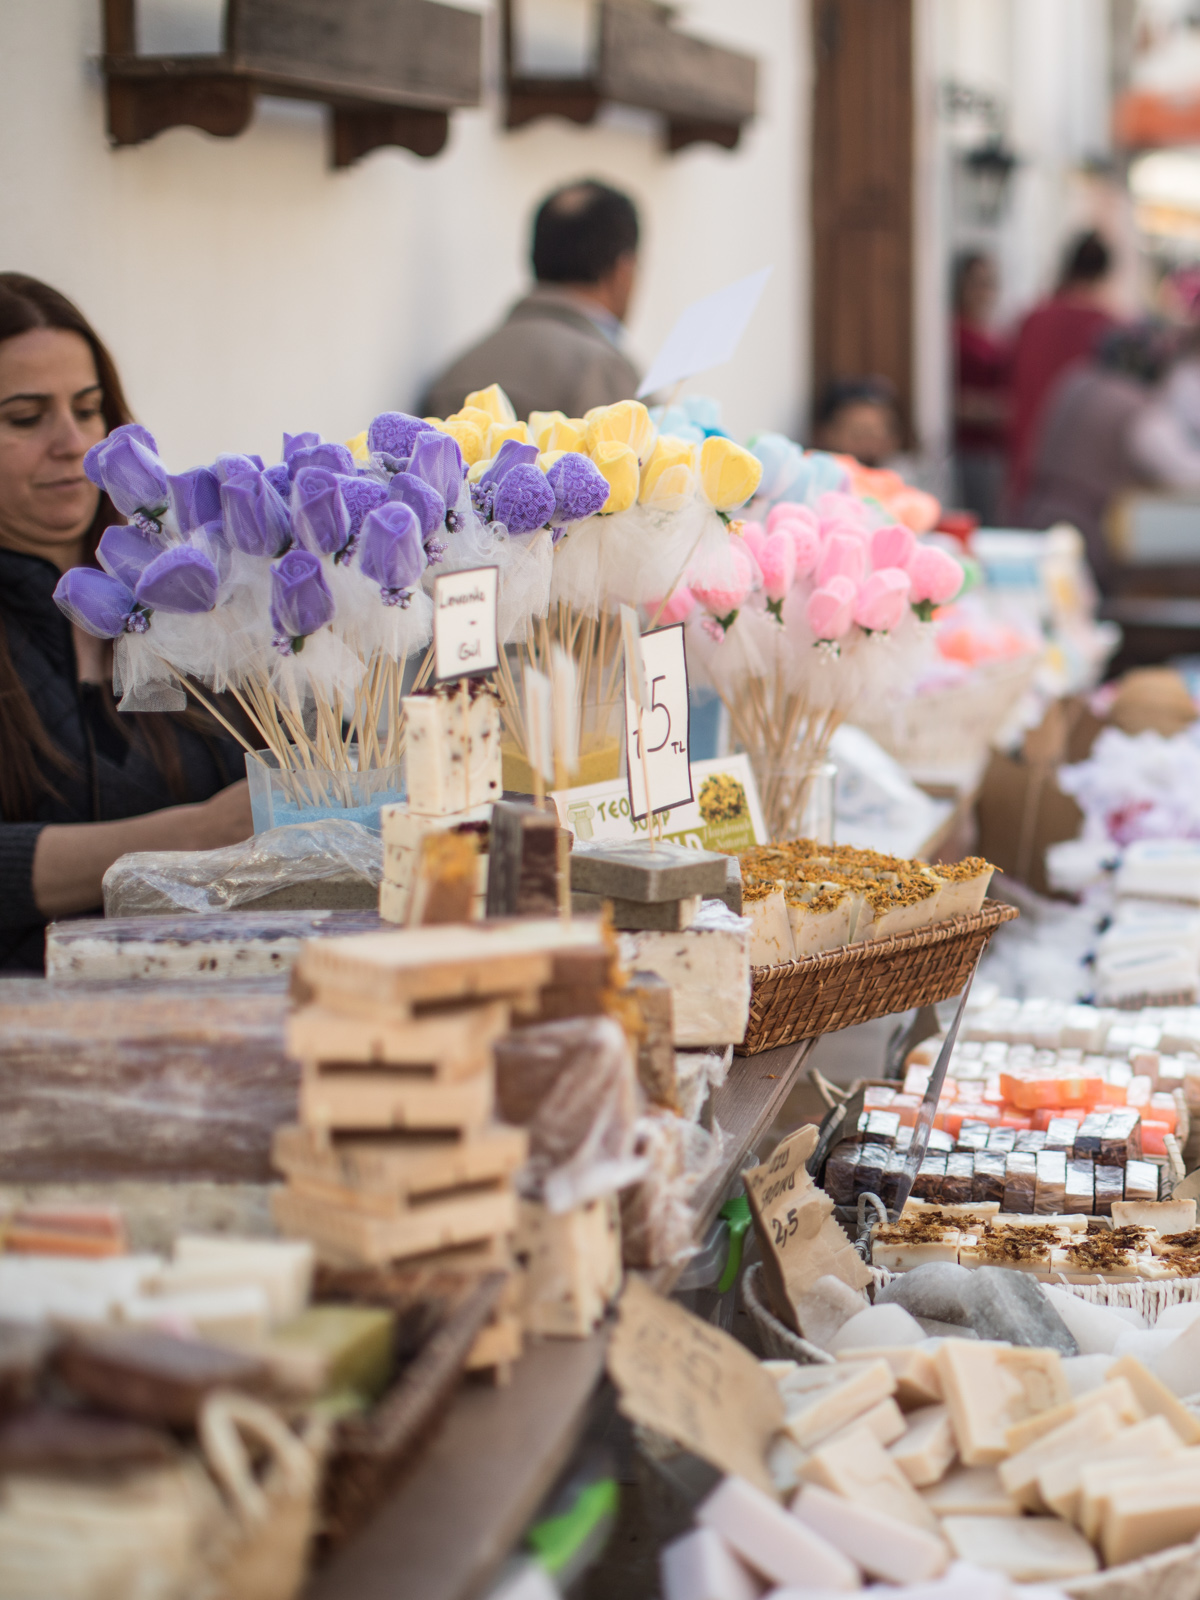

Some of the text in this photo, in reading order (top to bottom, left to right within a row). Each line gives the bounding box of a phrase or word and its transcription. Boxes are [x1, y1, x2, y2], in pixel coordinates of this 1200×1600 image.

[671, 741, 686, 755] TL
[597, 797, 631, 822] TEO
[772, 1208, 798, 1248] 2,5
